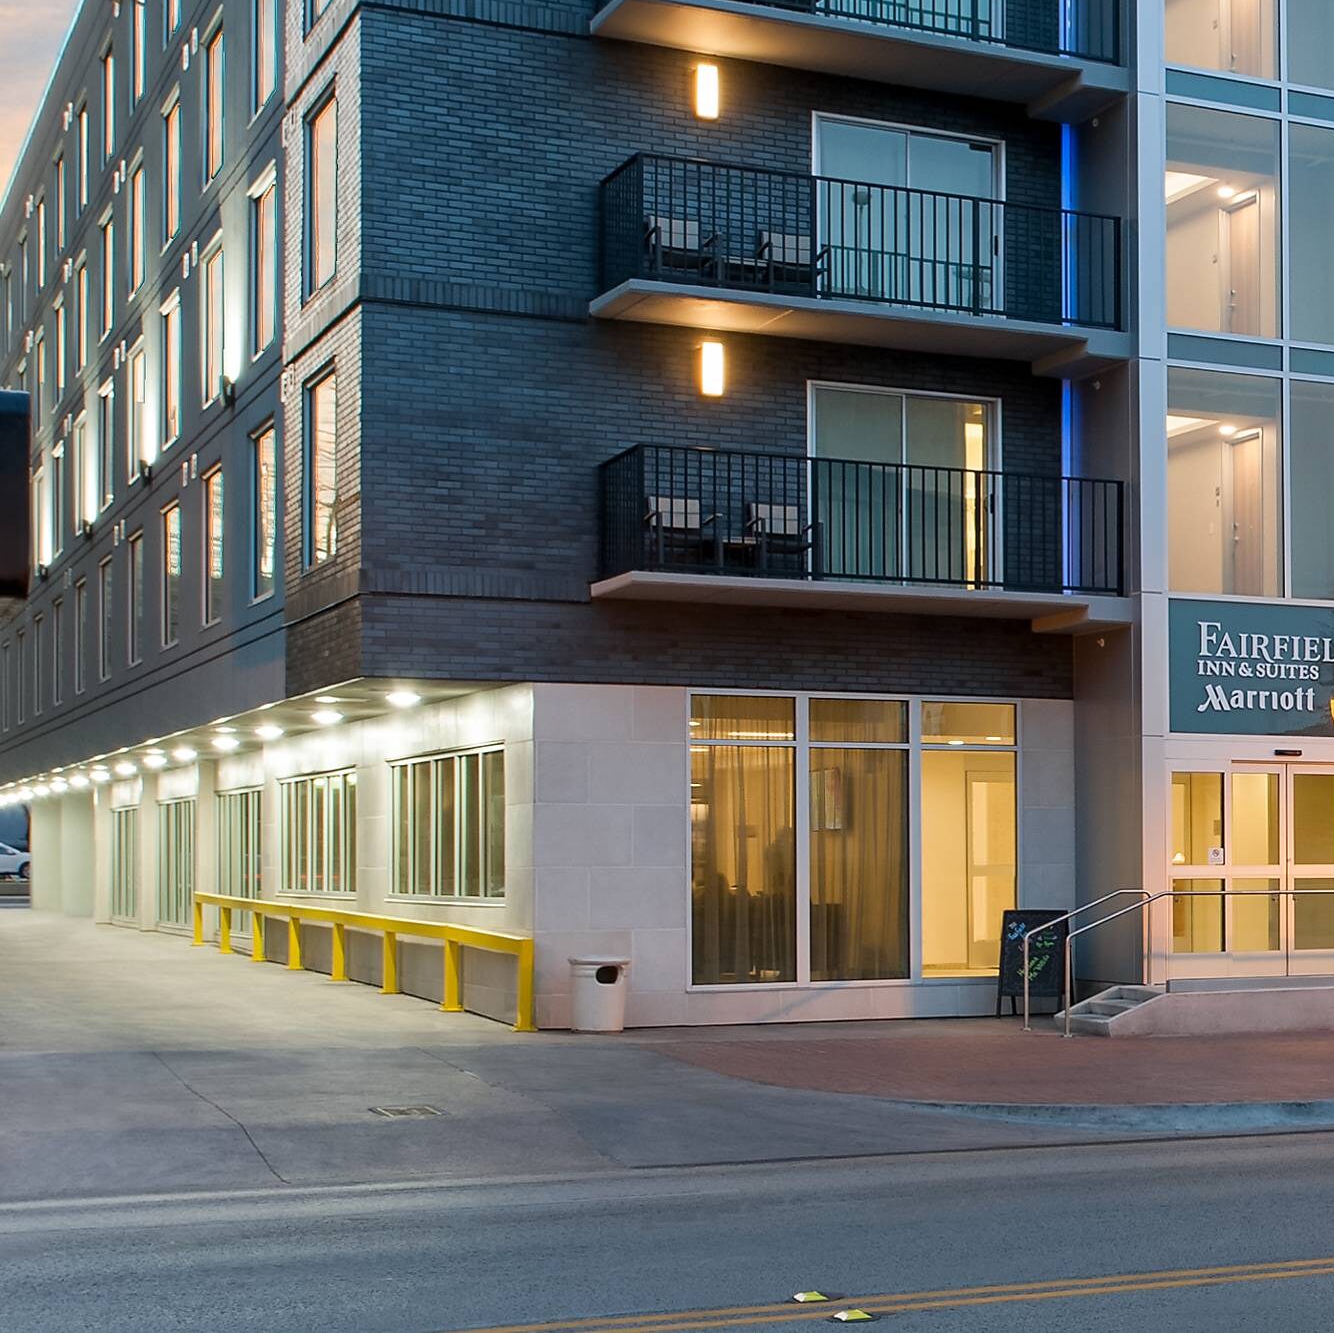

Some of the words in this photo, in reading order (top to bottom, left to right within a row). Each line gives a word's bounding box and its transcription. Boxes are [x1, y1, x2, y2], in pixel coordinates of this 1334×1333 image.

[1198, 660, 1234, 677] INN
[1239, 662, 1253, 678] &
[1256, 663, 1319, 680] SUITES
[1198, 684, 1315, 712] Marriott
